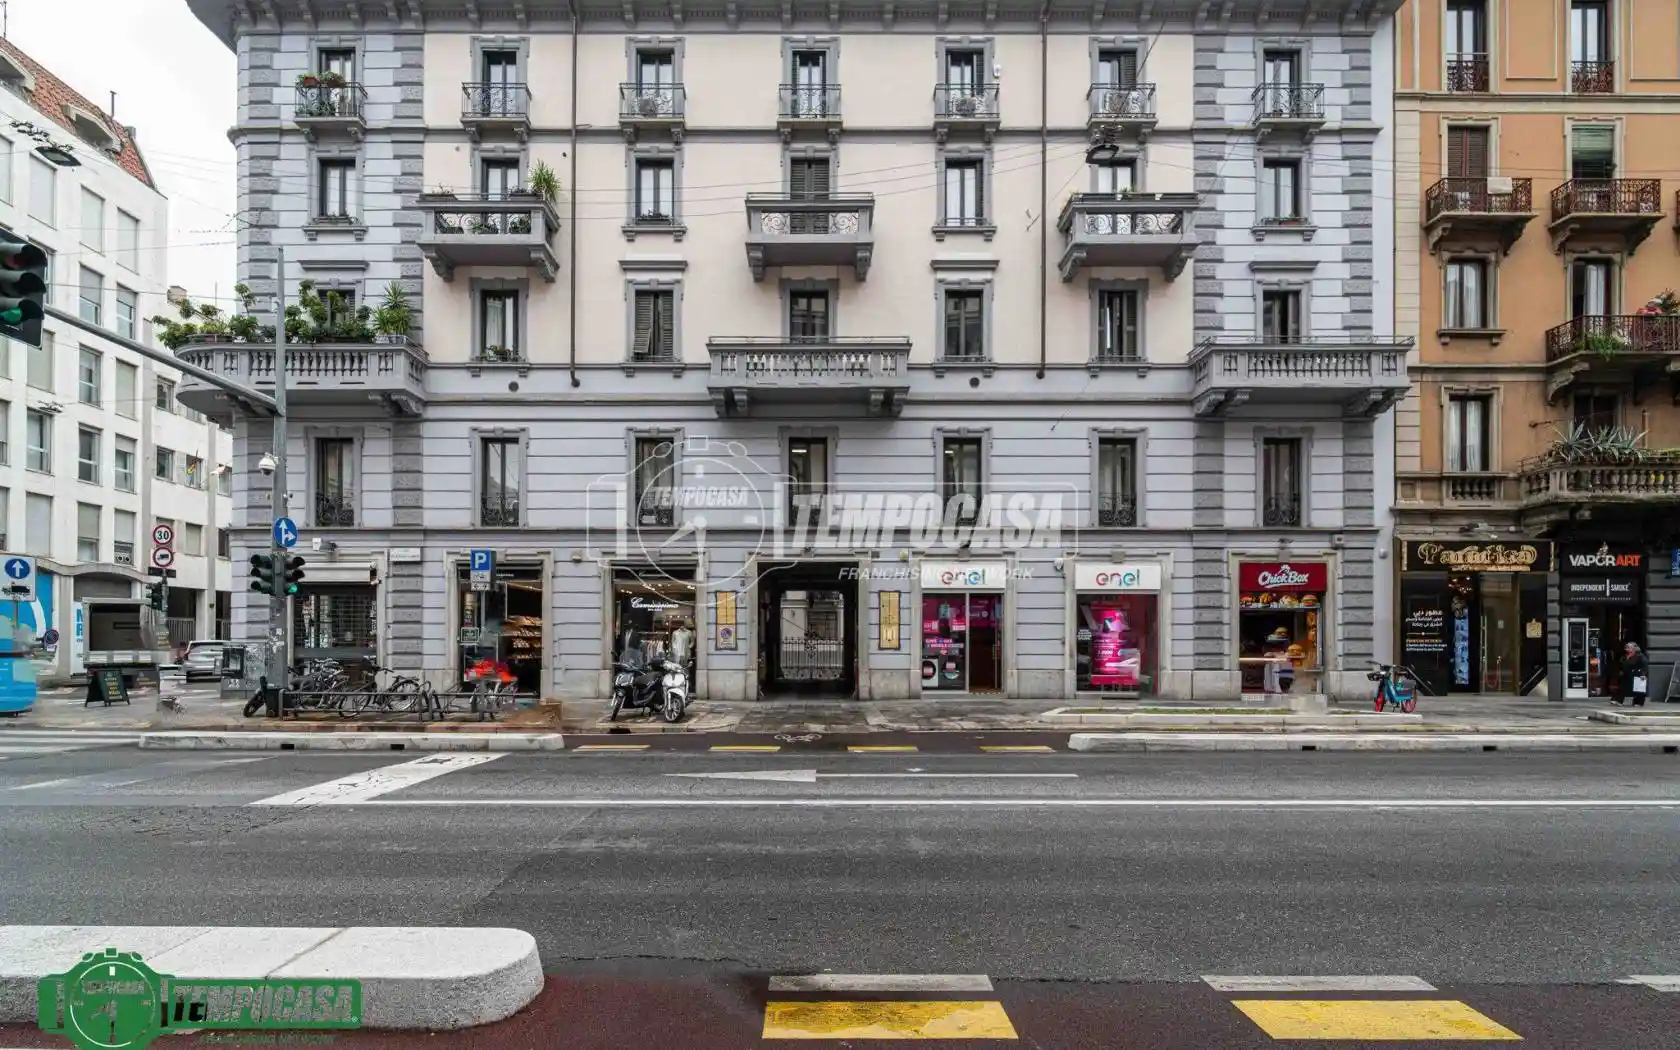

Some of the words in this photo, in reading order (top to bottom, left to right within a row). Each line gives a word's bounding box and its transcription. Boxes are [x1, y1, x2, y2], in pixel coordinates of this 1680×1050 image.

[157, 531, 169, 540] 30
[474, 552, 487, 569] P
[941, 569, 986, 585] enel
[1096, 569, 1140, 587] enel
[1570, 584, 1605, 592] INDEPENDENT
[1610, 584, 1629, 592] SMOKE
